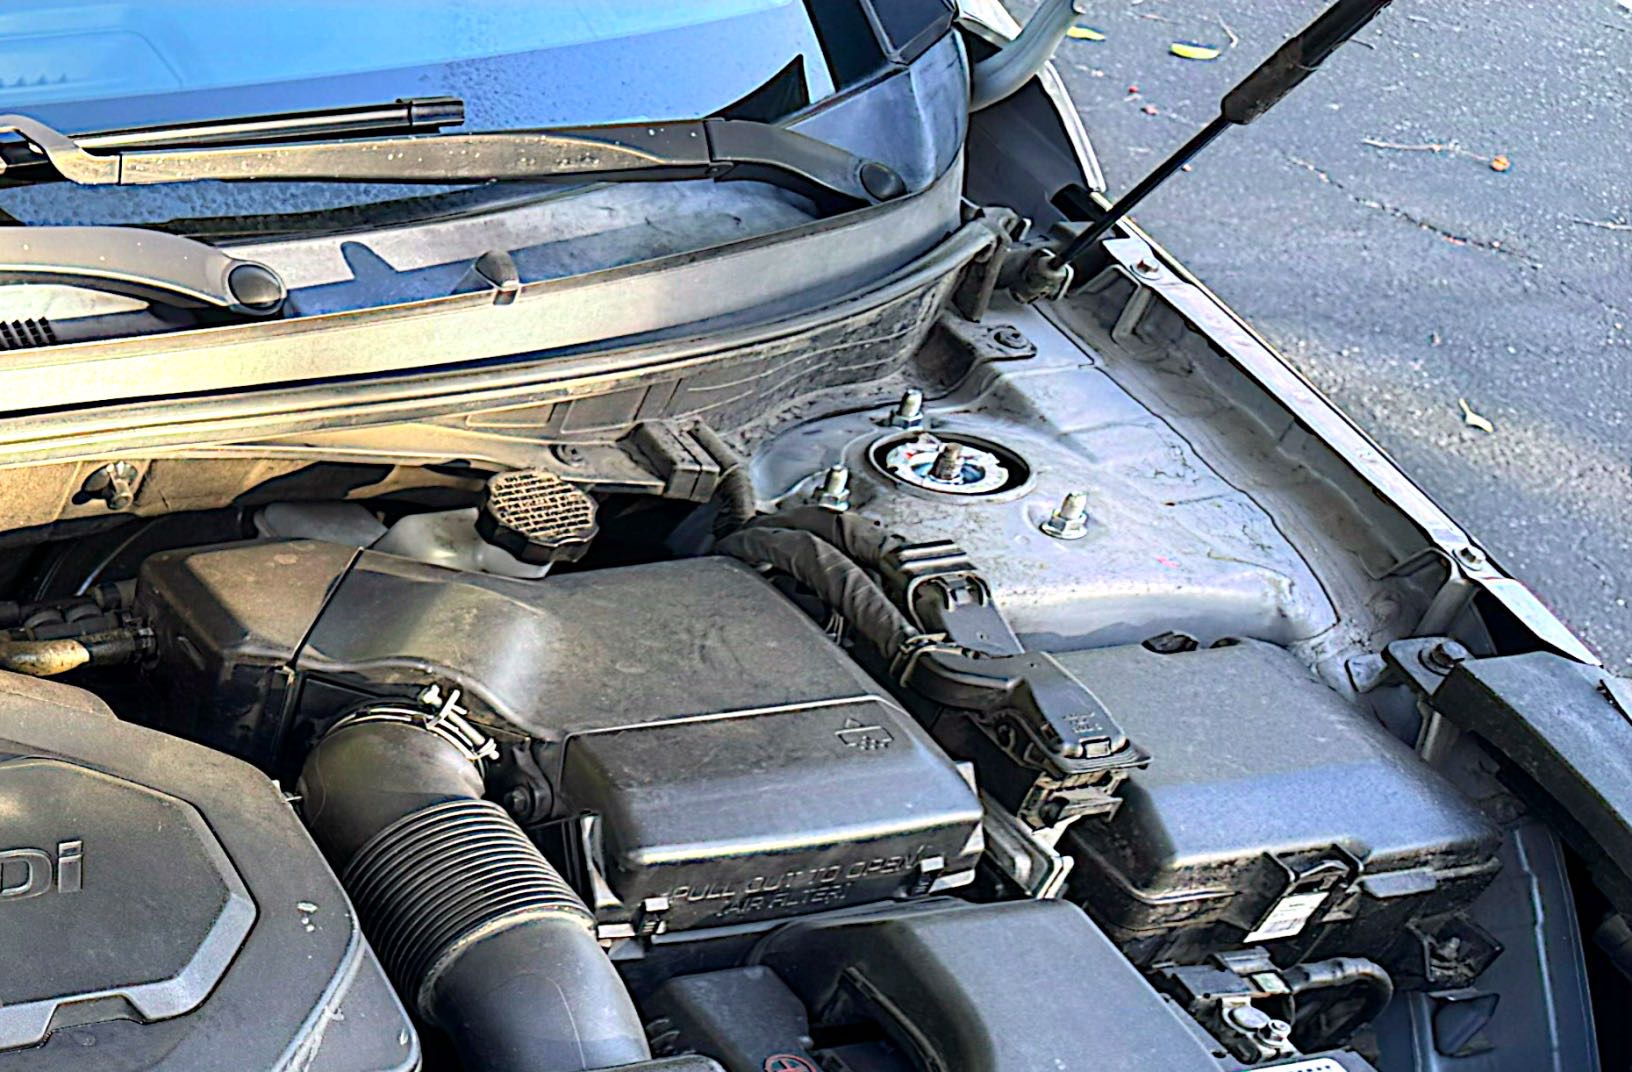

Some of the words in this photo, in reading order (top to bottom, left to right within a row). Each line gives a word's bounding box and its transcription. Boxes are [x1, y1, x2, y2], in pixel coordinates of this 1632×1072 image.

[671, 885, 735, 904] PULL
[744, 870, 804, 894] OUT
[806, 864, 841, 886] TO
[845, 847, 924, 880] OPEN
